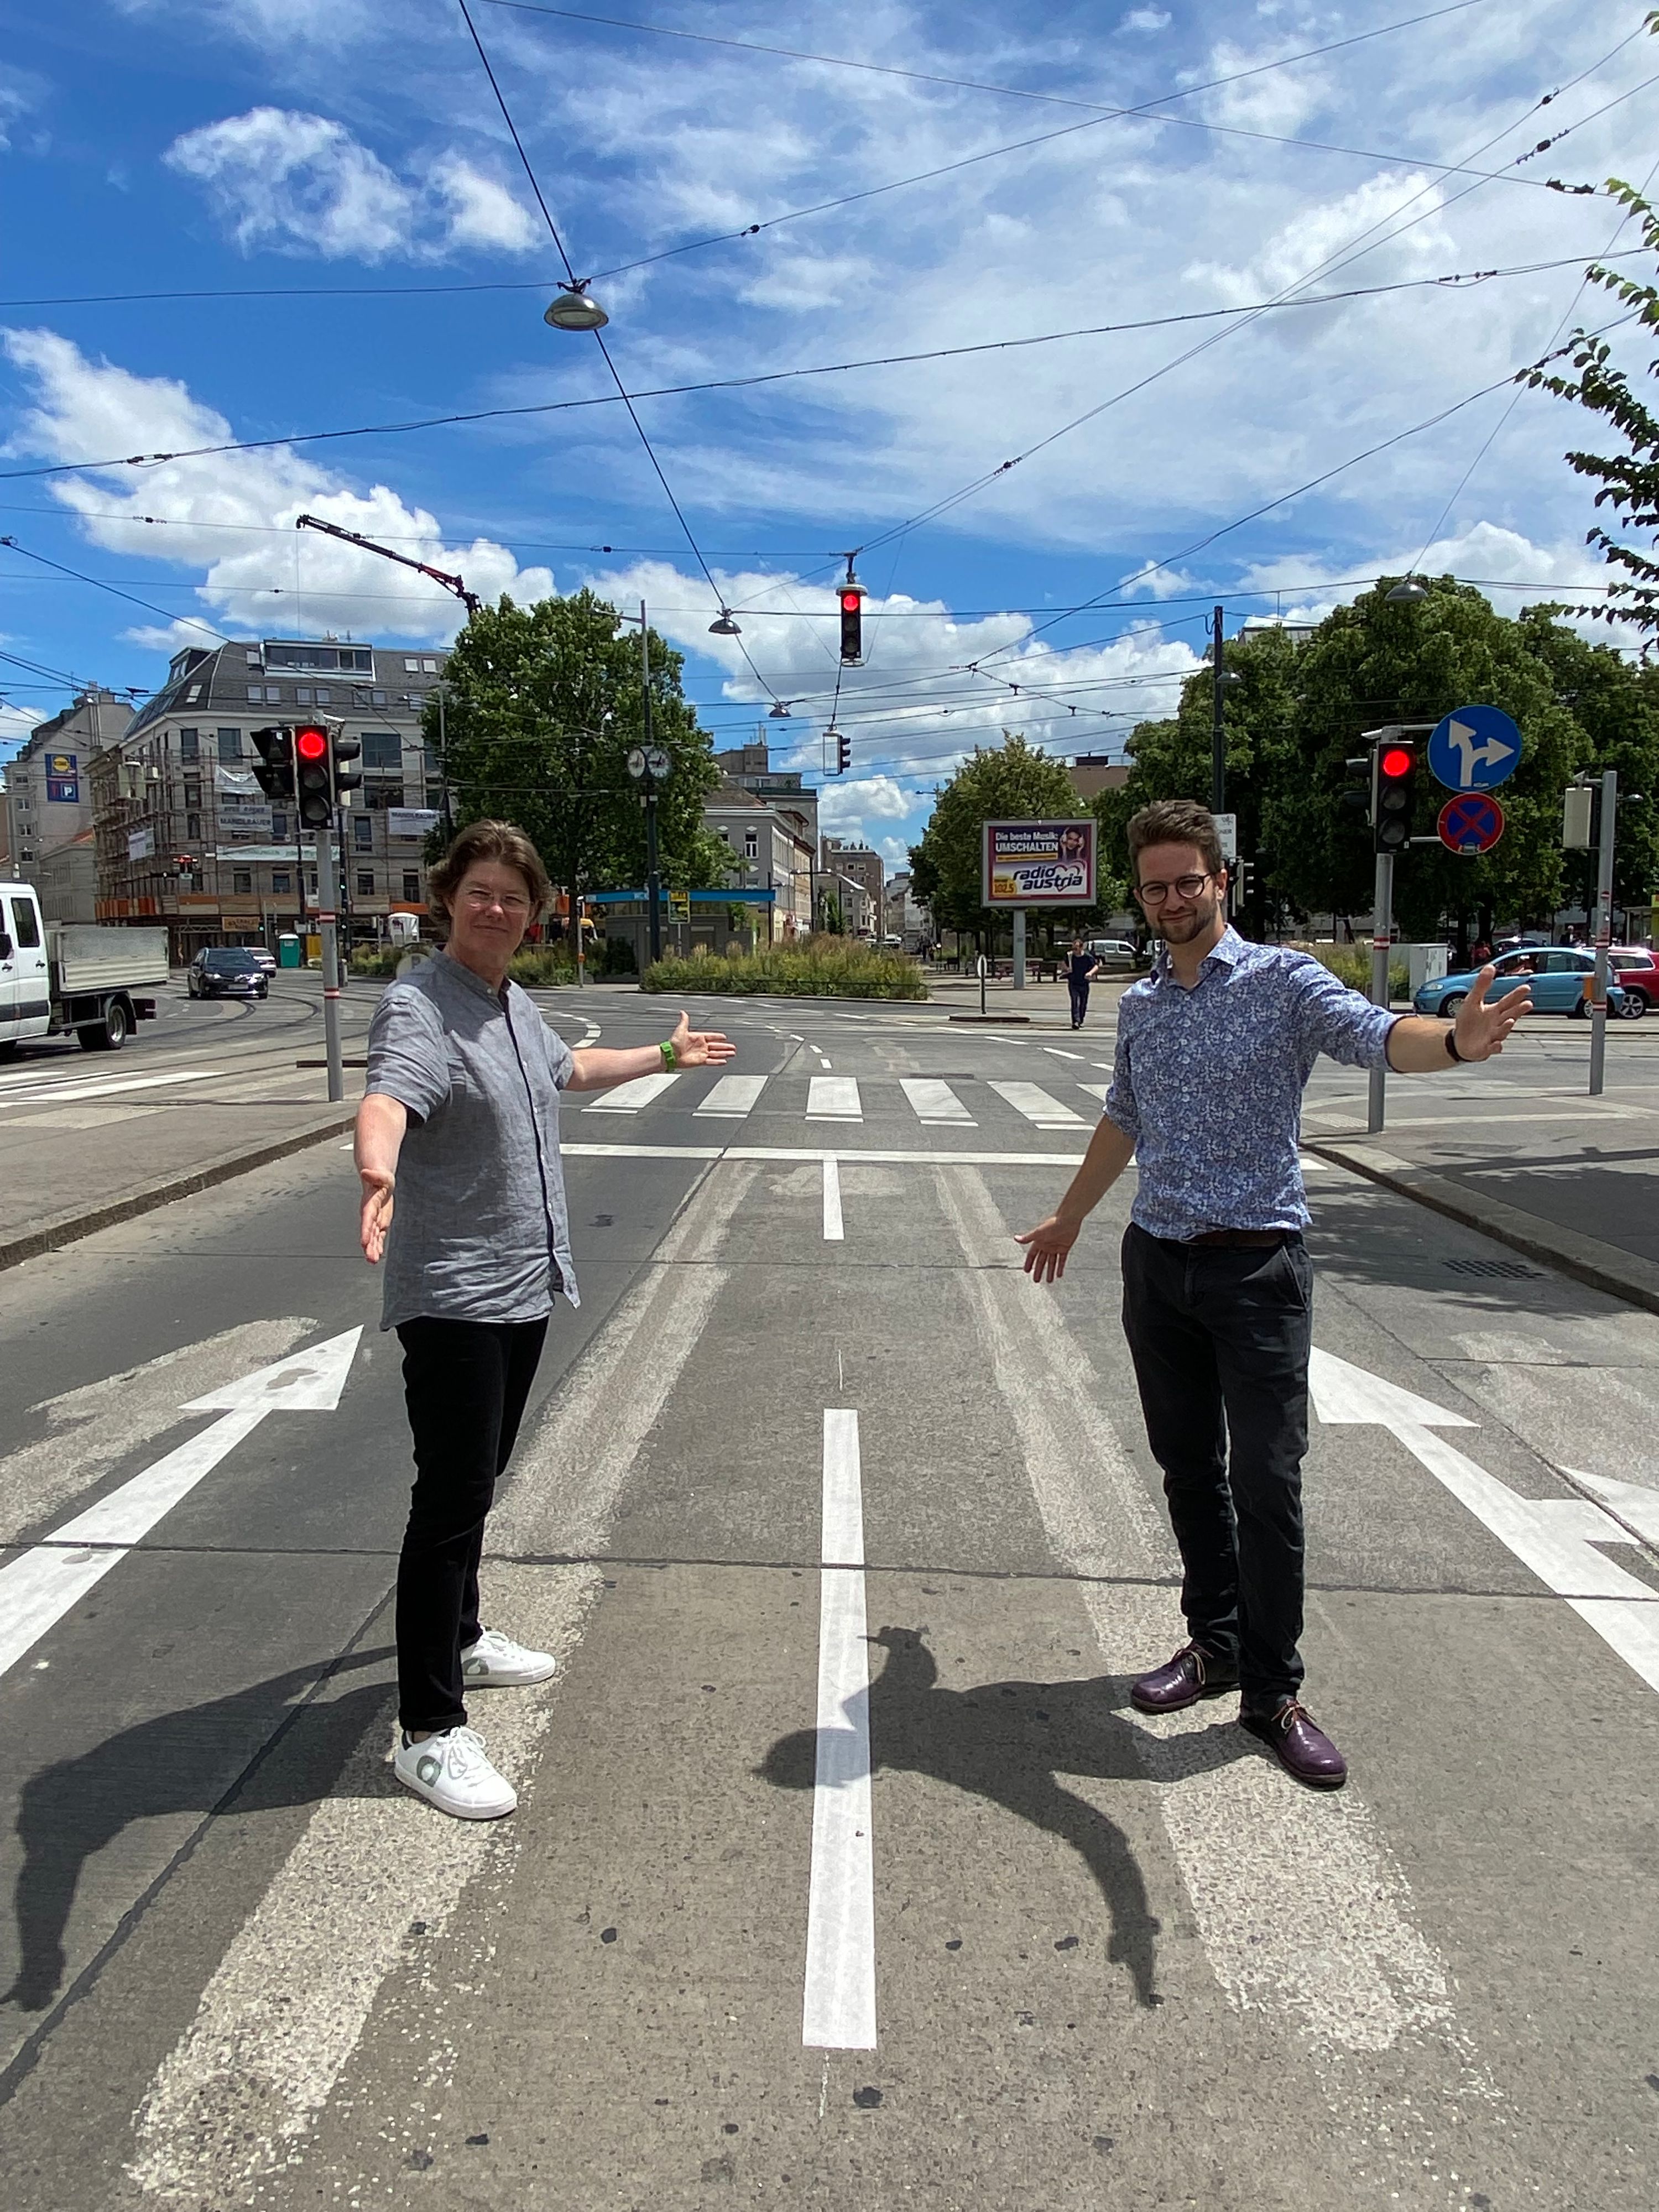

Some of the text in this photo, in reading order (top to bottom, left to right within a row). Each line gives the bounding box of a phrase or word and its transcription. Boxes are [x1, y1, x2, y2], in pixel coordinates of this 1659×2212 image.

[995, 832, 1008, 841] Die
[1010, 832, 1031, 841] beste
[995, 842, 1058, 852] UMSCHALTEN
[1013, 865, 1056, 880] radio
[1022, 874, 1083, 890] austria
